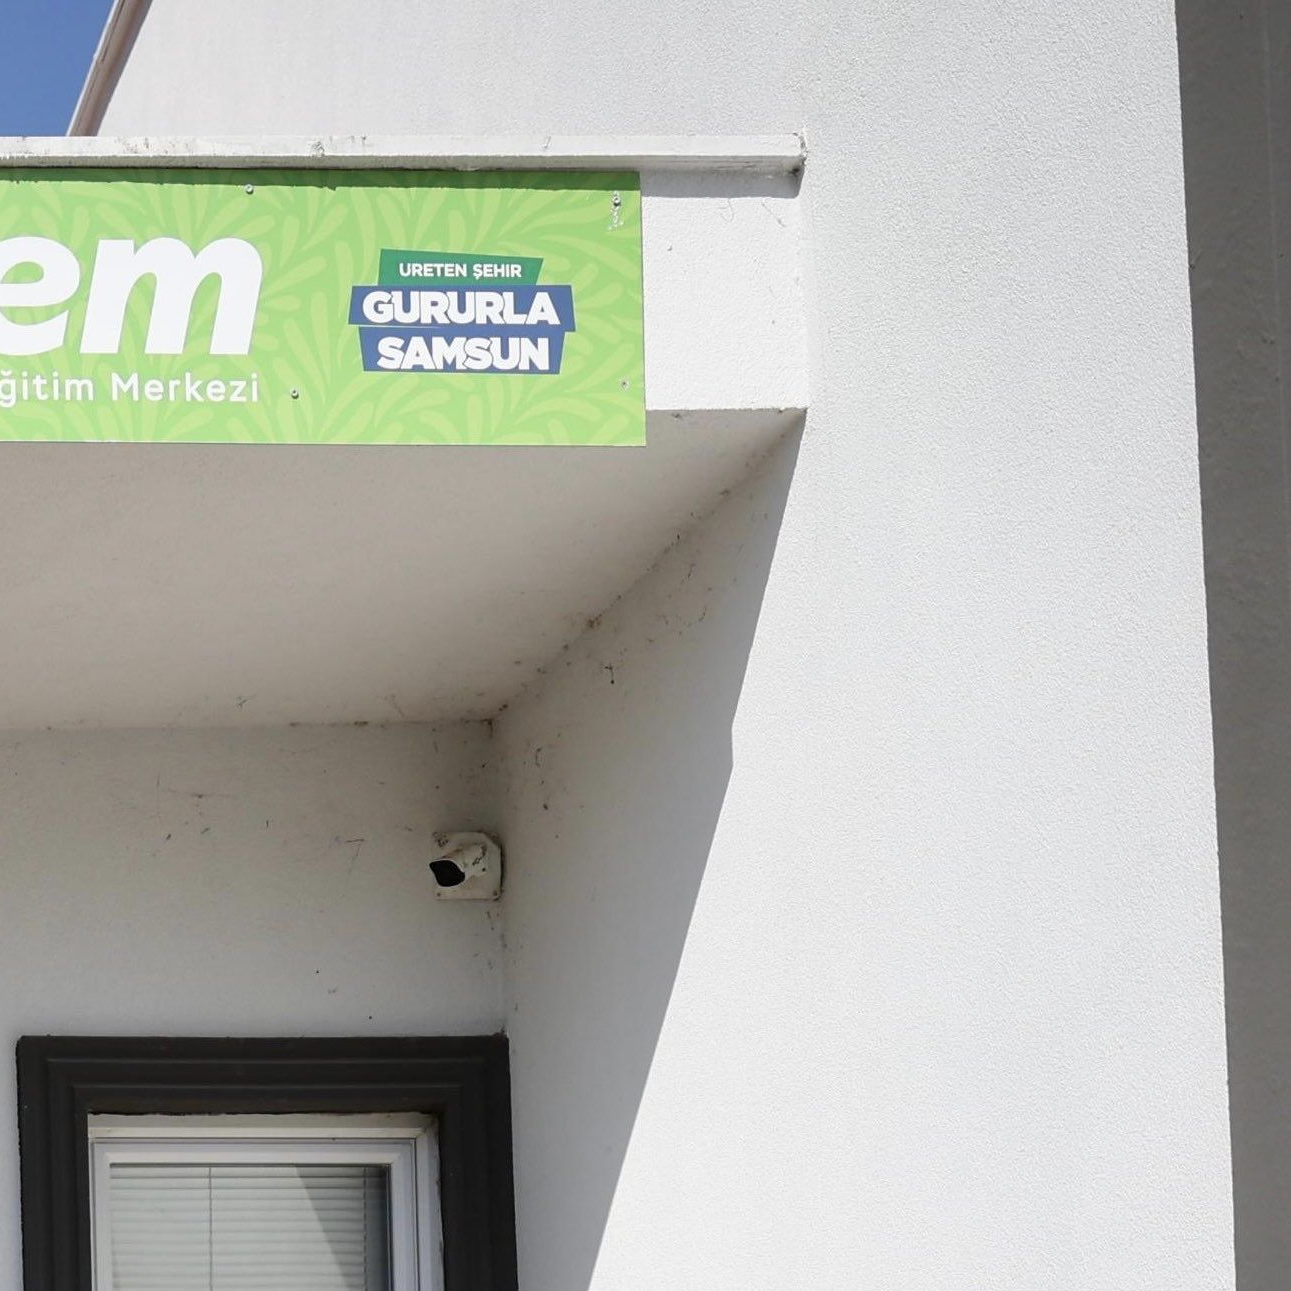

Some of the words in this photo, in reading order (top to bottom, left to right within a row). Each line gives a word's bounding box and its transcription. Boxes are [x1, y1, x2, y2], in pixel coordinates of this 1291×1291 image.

[362, 290, 560, 325] GURURLA
[376, 336, 549, 371] SAMSUN
[111, 372, 259, 402] Merkezi
